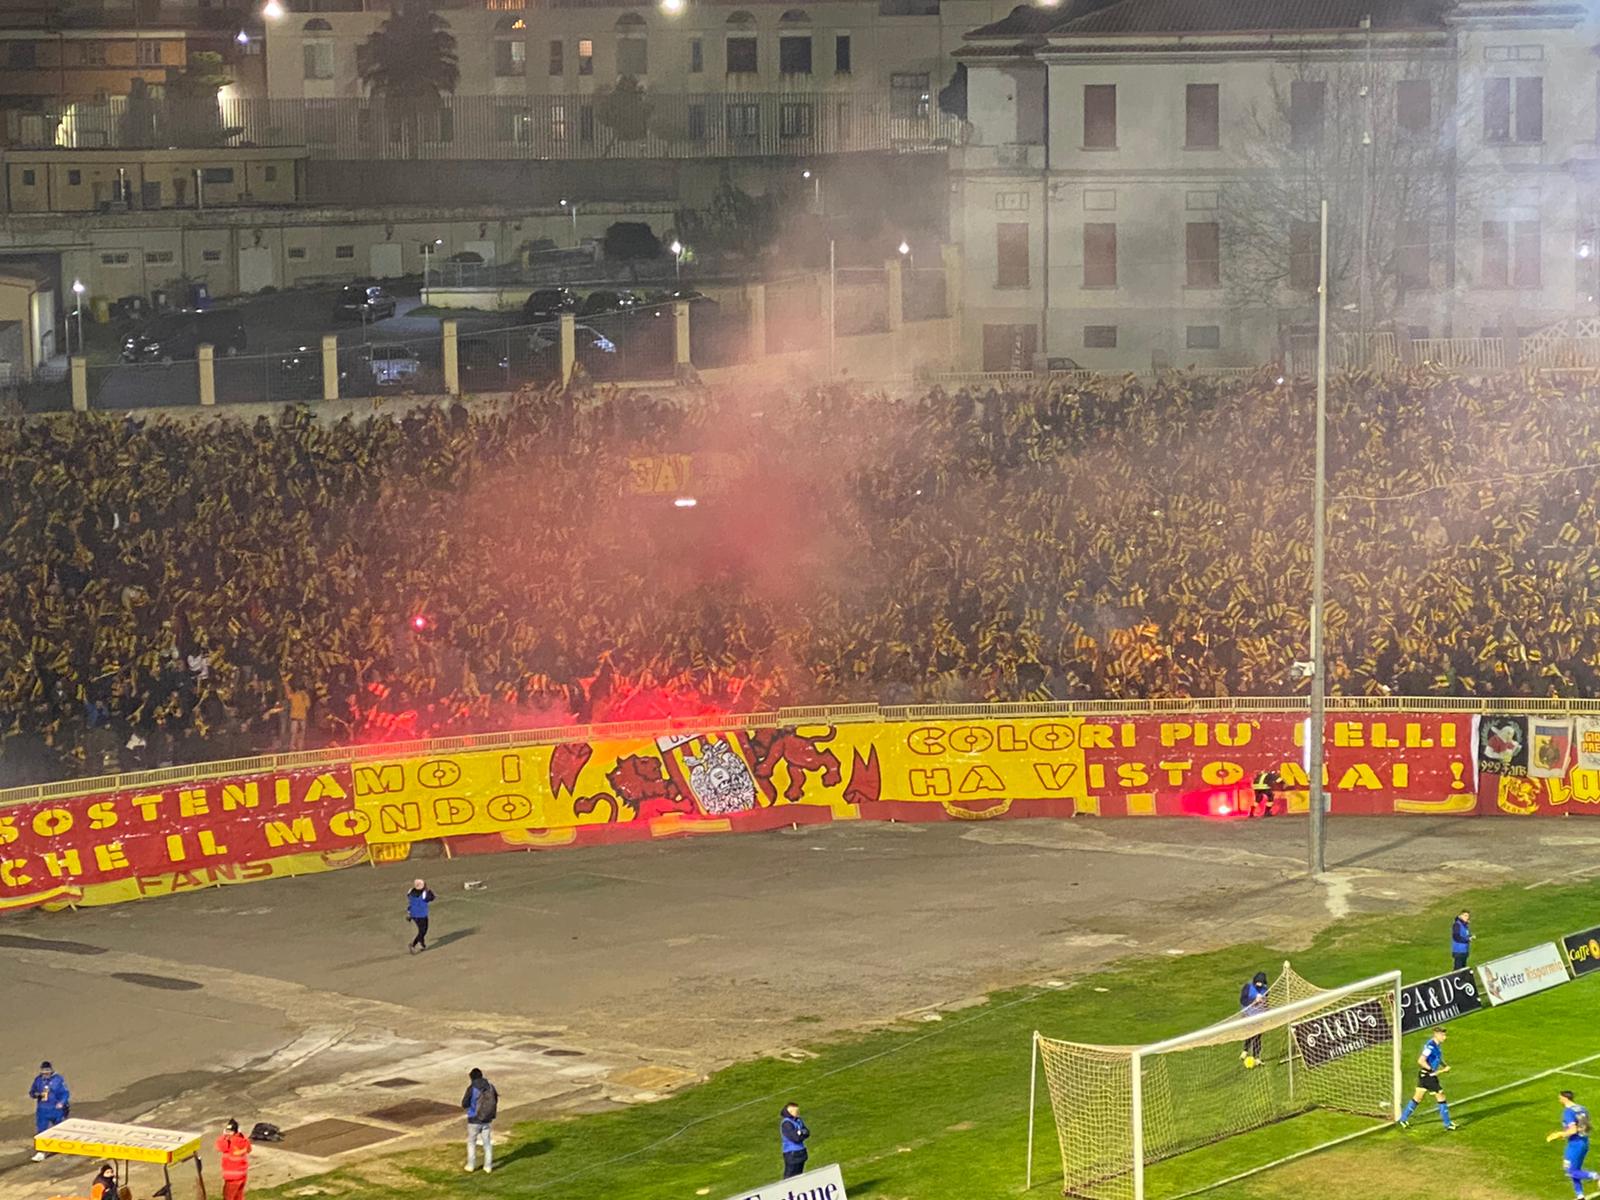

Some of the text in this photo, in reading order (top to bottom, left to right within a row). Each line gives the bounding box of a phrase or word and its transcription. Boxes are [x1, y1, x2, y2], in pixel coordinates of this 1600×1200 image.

[0, 758, 461, 845] SOSTENIAMO
[501, 754, 521, 784] I
[906, 723, 1137, 756] COLORI
[0, 840, 130, 887] CHE
[166, 830, 229, 862] IL
[264, 794, 534, 848] MONDO
[908, 764, 1006, 797] HA
[1032, 760, 1244, 791] VISTO
[138, 861, 275, 895] FANS
